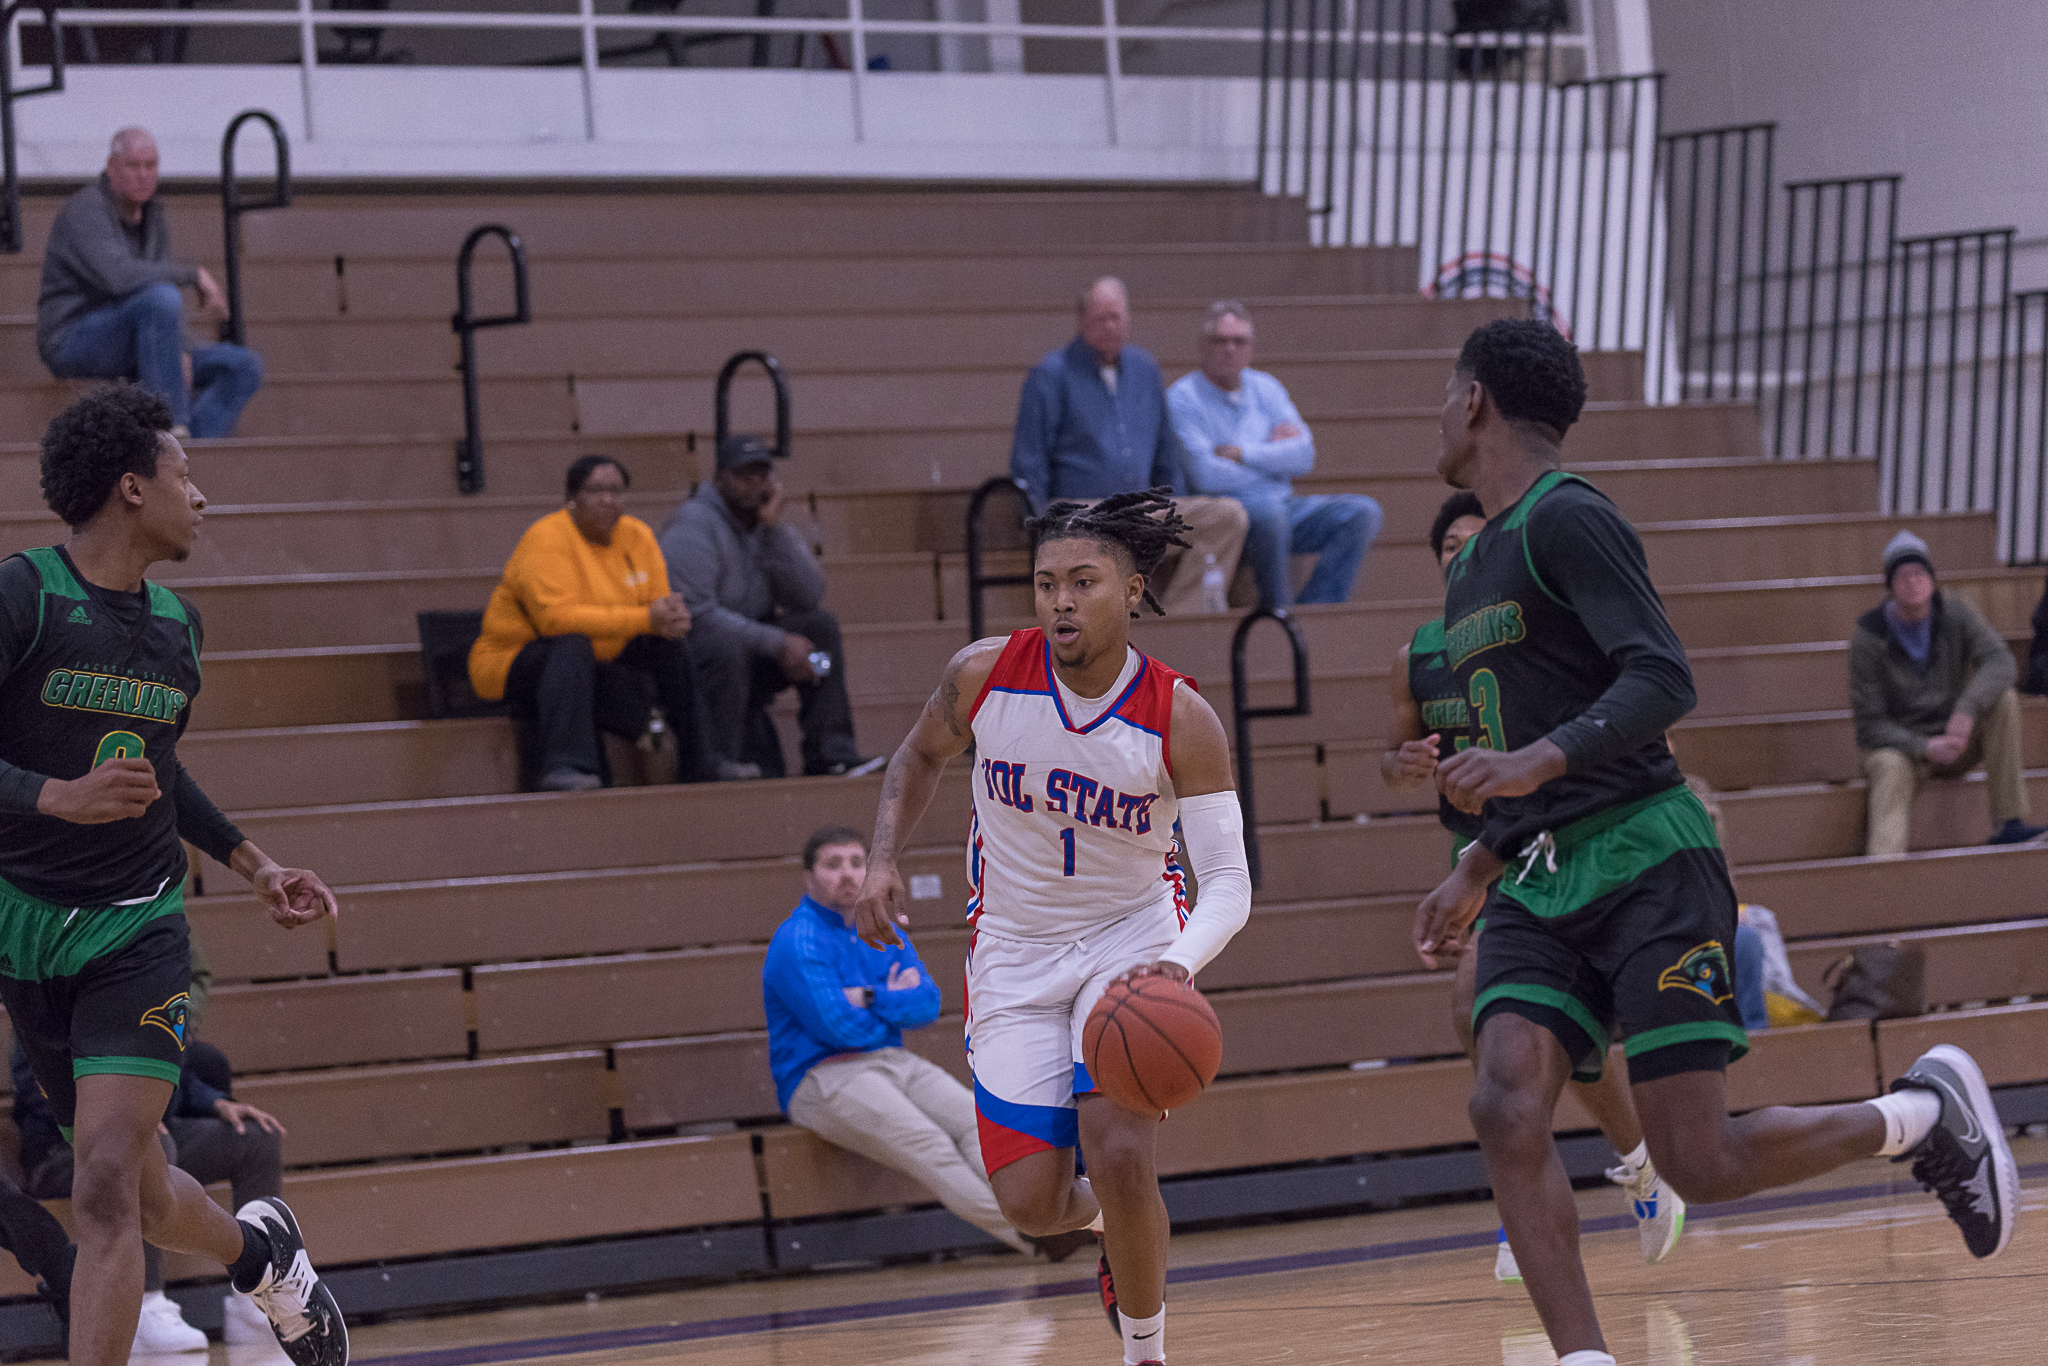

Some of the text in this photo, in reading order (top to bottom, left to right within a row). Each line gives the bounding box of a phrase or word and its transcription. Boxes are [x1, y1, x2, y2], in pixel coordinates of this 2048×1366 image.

[41, 669, 187, 723] GREENJAYS
[1046, 768, 1160, 835] STATE
[1060, 827, 1076, 876] 1
